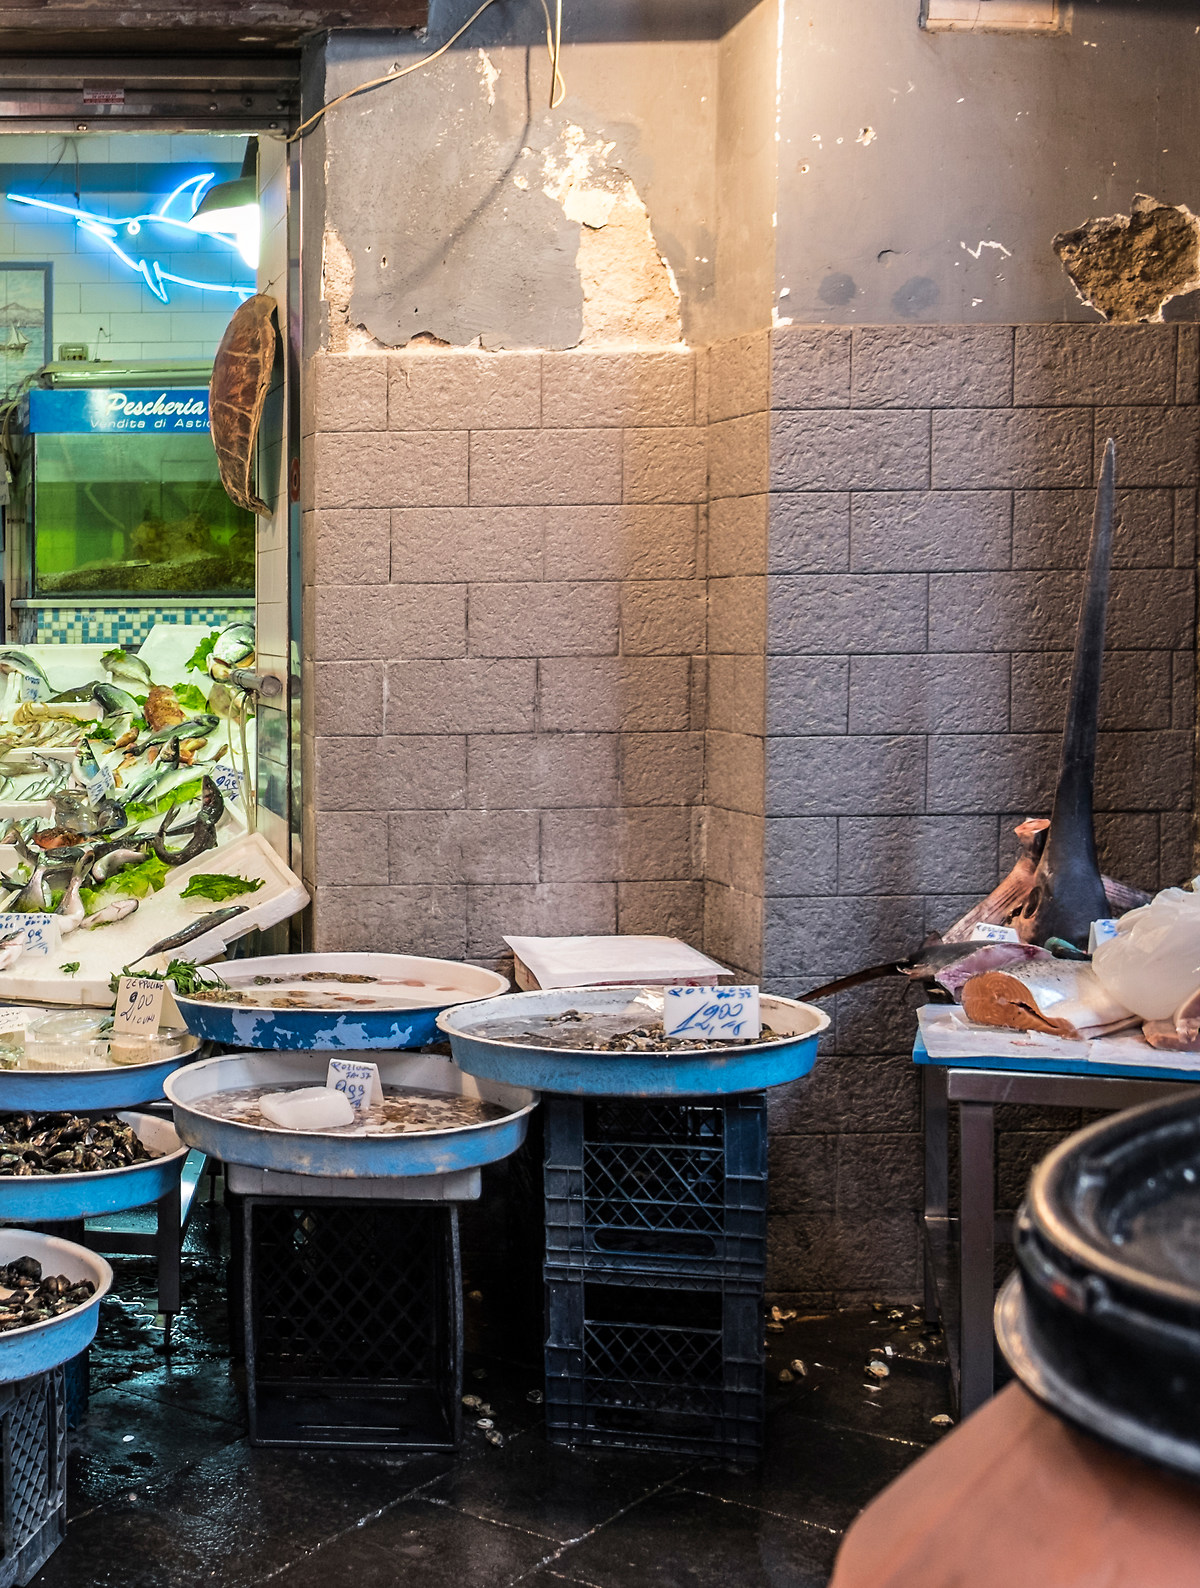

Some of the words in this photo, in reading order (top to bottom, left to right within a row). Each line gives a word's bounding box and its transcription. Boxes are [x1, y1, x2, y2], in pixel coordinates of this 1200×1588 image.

[106, 392, 206, 416] Pescheria
[91, 419, 146, 429] Vendita
[154, 419, 166, 429] di
